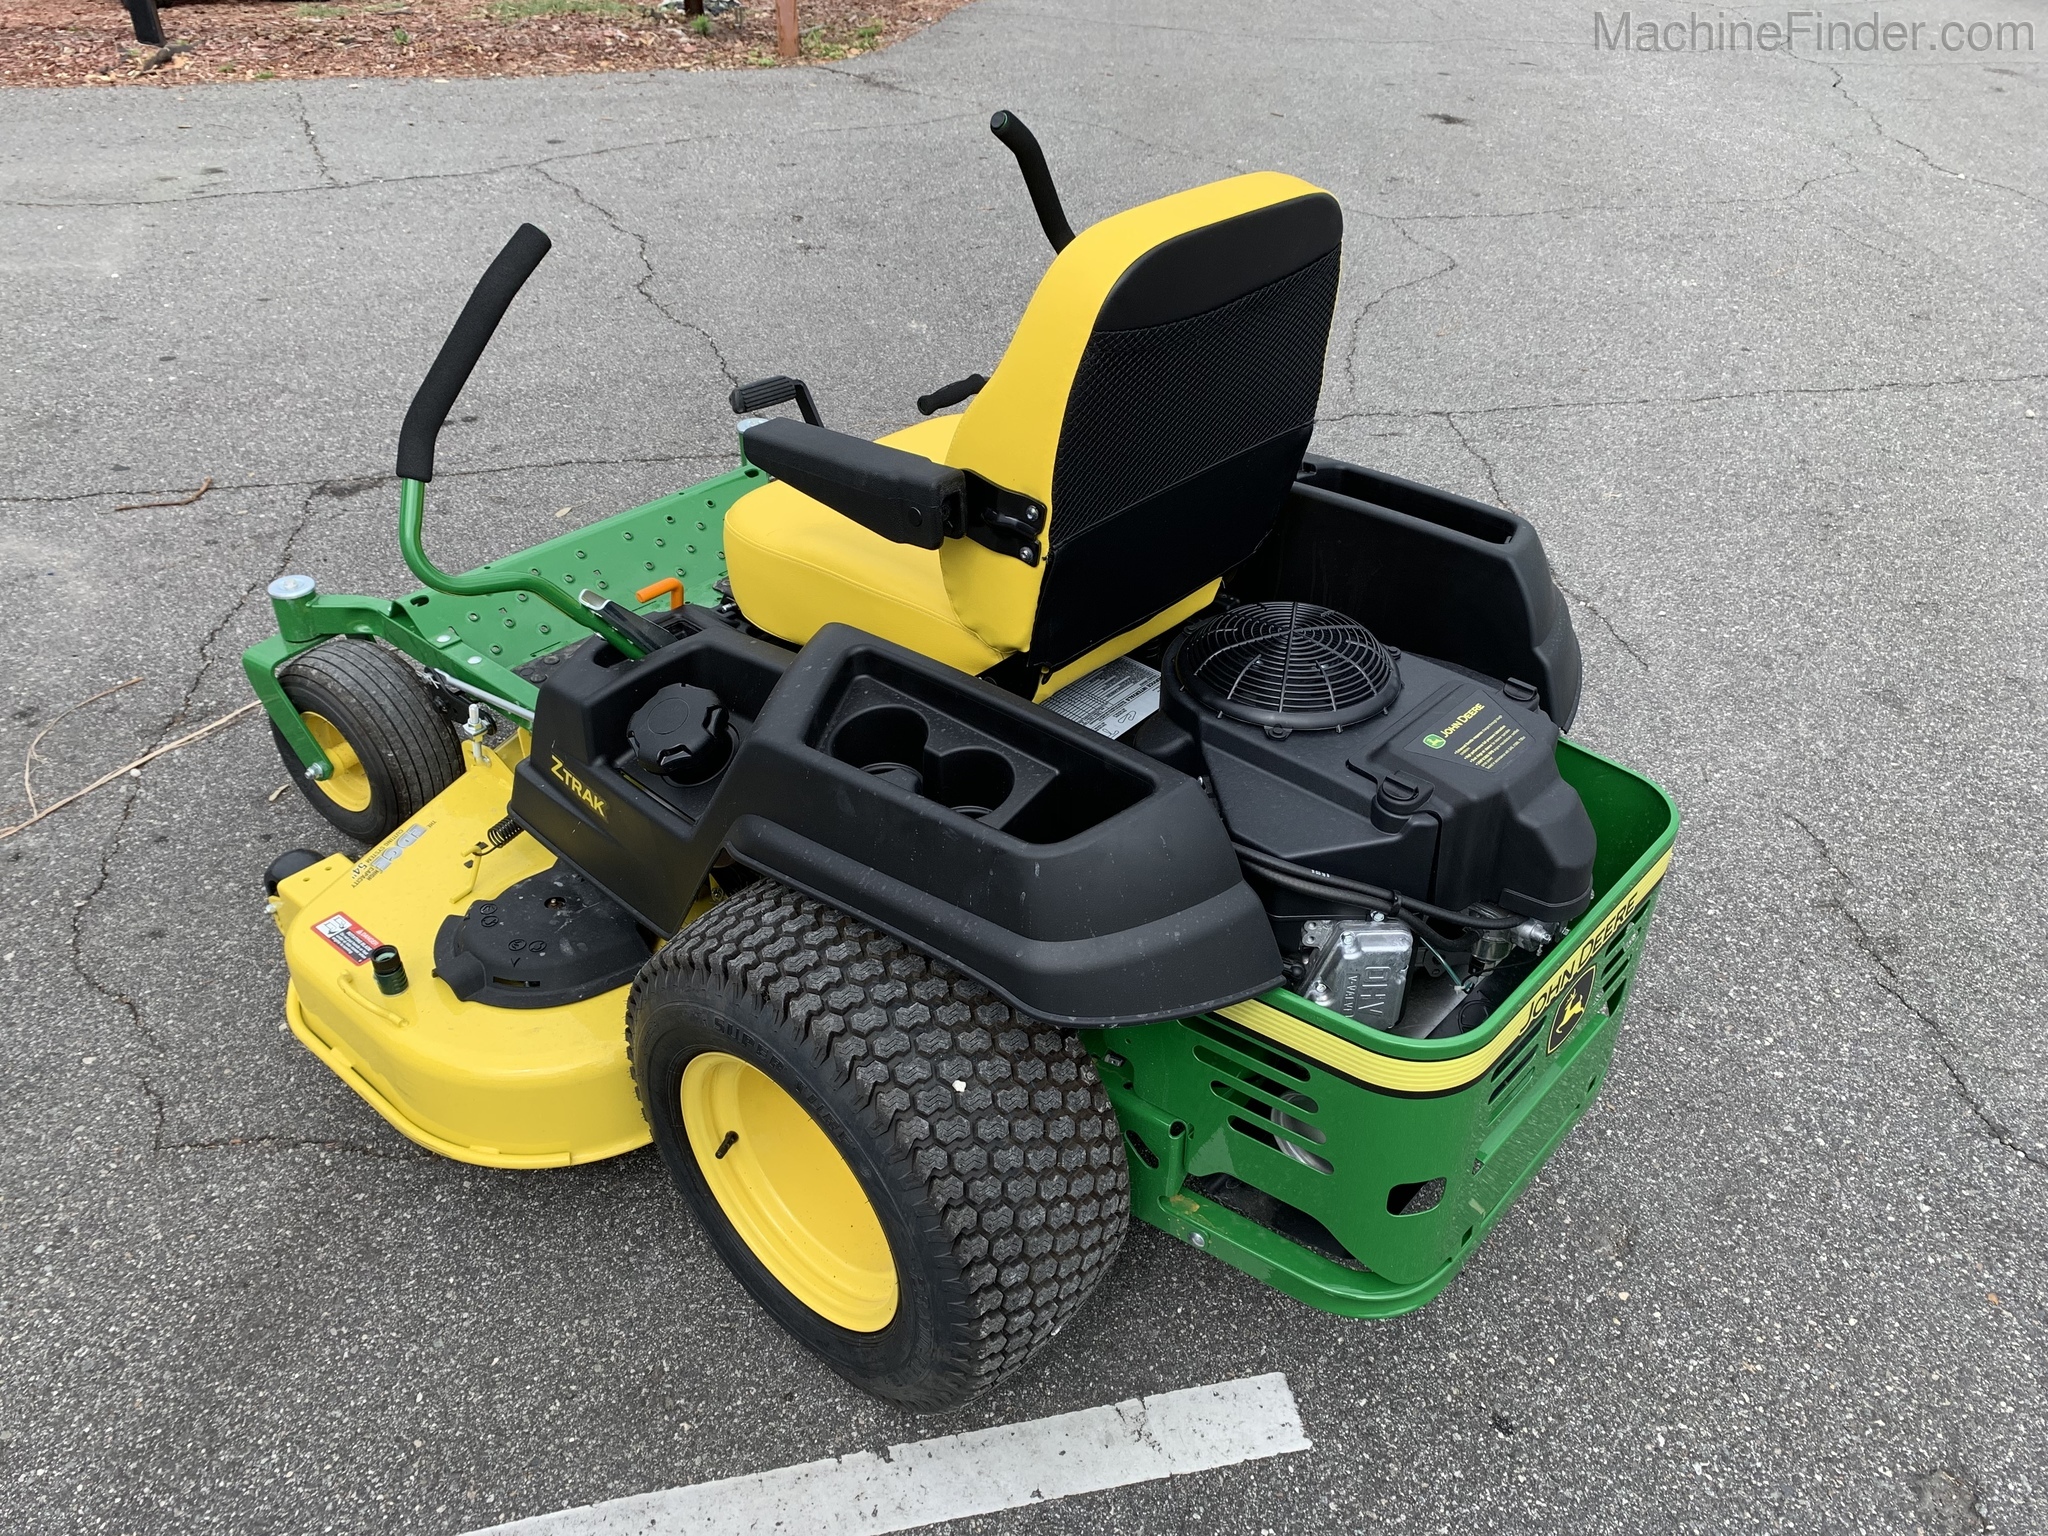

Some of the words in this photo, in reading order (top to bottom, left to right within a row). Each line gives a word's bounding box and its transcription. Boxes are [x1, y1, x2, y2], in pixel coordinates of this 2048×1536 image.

[1440, 720, 1463, 738] JOHN
[1457, 702, 1485, 724] DEERE
[551, 755, 605, 817] ZTRAK
[366, 846, 385, 864] SYSTEM
[370, 823, 427, 872] EDGE
[384, 829, 404, 847] CUTTING
[351, 867, 375, 888] CAPACITY
[361, 931, 380, 947] DANGER
[1518, 960, 1576, 1036] JOHN
[1577, 892, 1638, 972] DEERE
[712, 1017, 788, 1072] SUPER
[795, 1076, 854, 1145] TURF
